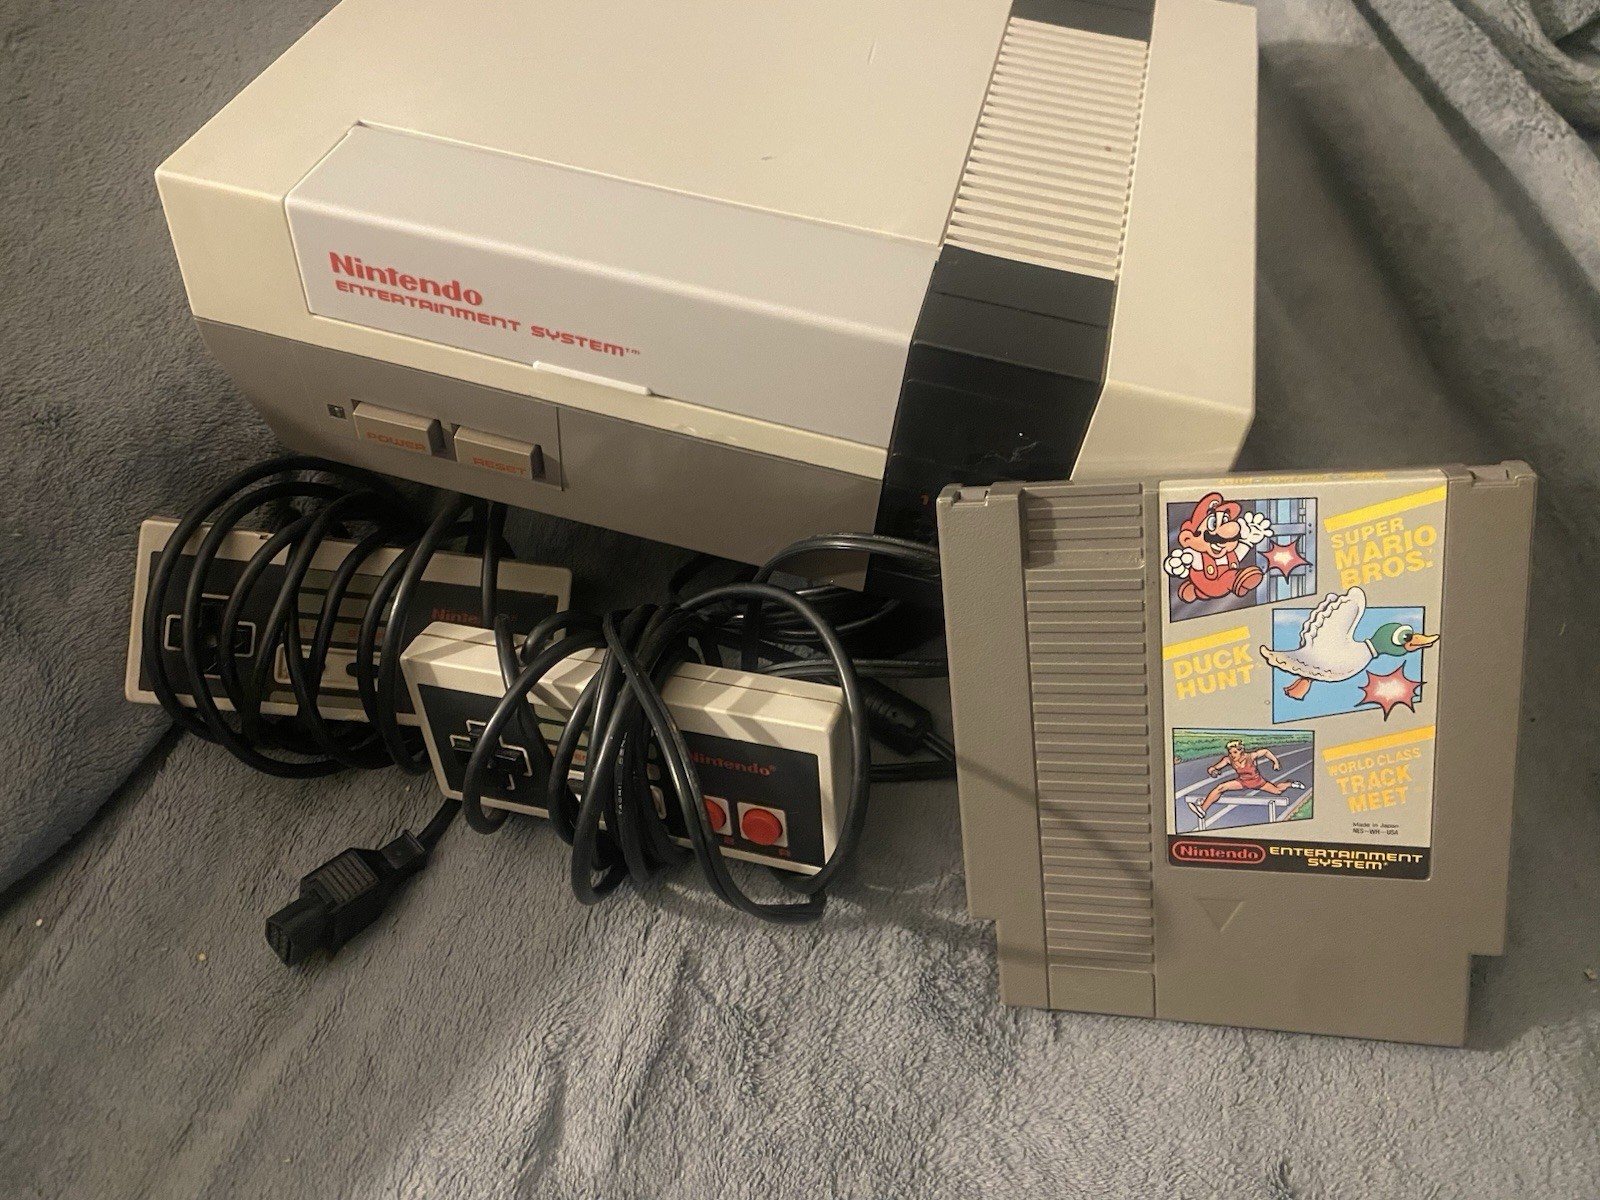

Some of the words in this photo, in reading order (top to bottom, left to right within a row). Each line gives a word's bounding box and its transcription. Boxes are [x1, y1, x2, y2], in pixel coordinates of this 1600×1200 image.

[329, 251, 483, 307] Nintendo
[335, 280, 521, 332] ENTERTAINMENT
[366, 431, 427, 451] POWER
[472, 456, 527, 476] RESET
[1331, 517, 1405, 549] SUPER
[1334, 524, 1437, 571] MARIO
[1173, 643, 1254, 680] DUCK
[1175, 664, 1255, 701] HUNT
[1327, 757, 1375, 777] WORLD
[1377, 747, 1422, 767] CLASS
[1336, 764, 1413, 796] TRACK
[1347, 785, 1409, 814] MEET
[1179, 845, 1259, 861] Nintendo
[1269, 846, 1423, 864] ENTERTAINMENT
